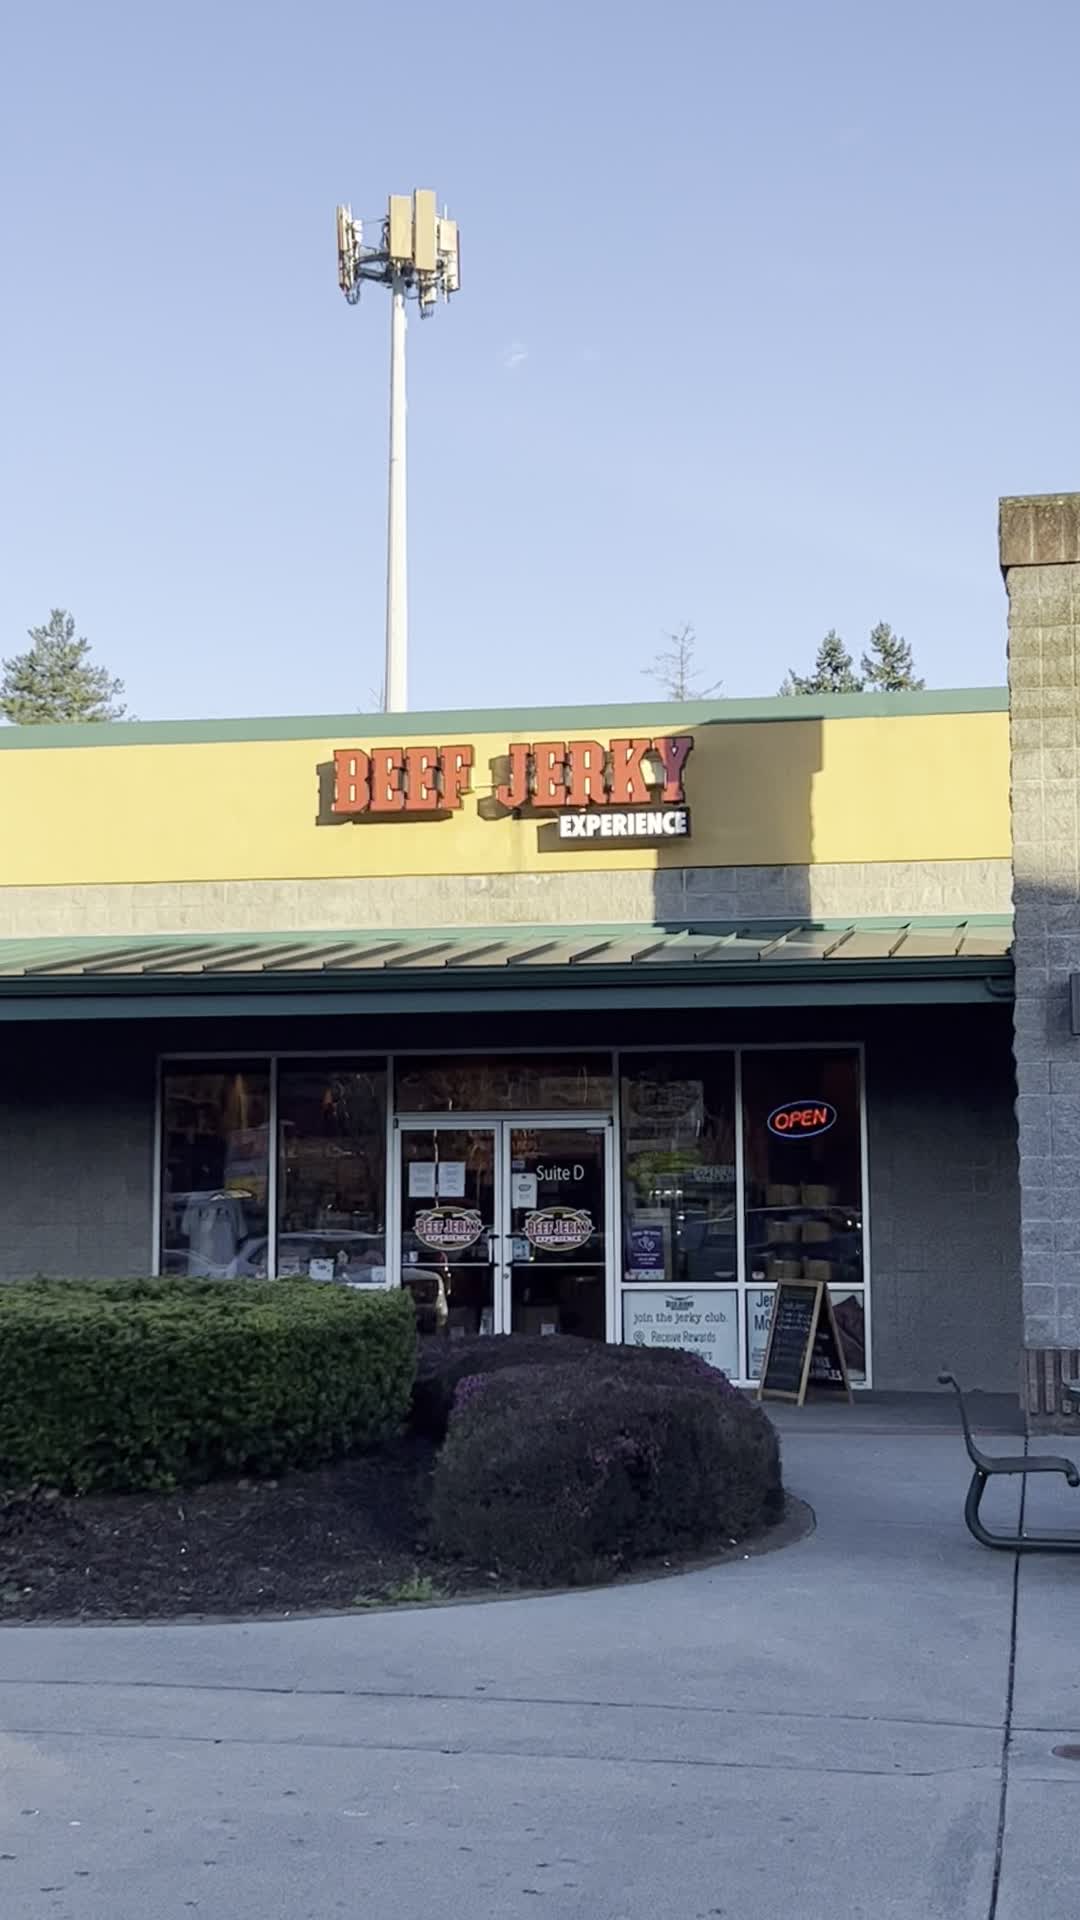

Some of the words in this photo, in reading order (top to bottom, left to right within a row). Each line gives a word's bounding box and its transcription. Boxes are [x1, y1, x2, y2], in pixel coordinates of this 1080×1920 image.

[332, 744, 474, 813] BEEF
[497, 736, 694, 808] JERKY
[559, 811, 687, 838] EXPERIENCE
[774, 1107, 828, 1130] OPEN
[536, 1165, 571, 1181] Suite
[573, 1165, 584, 1180] D
[416, 1219, 444, 1234] BEEF
[444, 1218, 482, 1234] JERKY
[527, 1219, 554, 1235] BEEF
[553, 1218, 593, 1234] JERKY
[633, 1312, 653, 1325] join
[656, 1312, 673, 1323] the
[674, 1311, 702, 1325] jerky
[651, 1330, 681, 1343] Receive
[683, 1330, 716, 1343] Rewards
